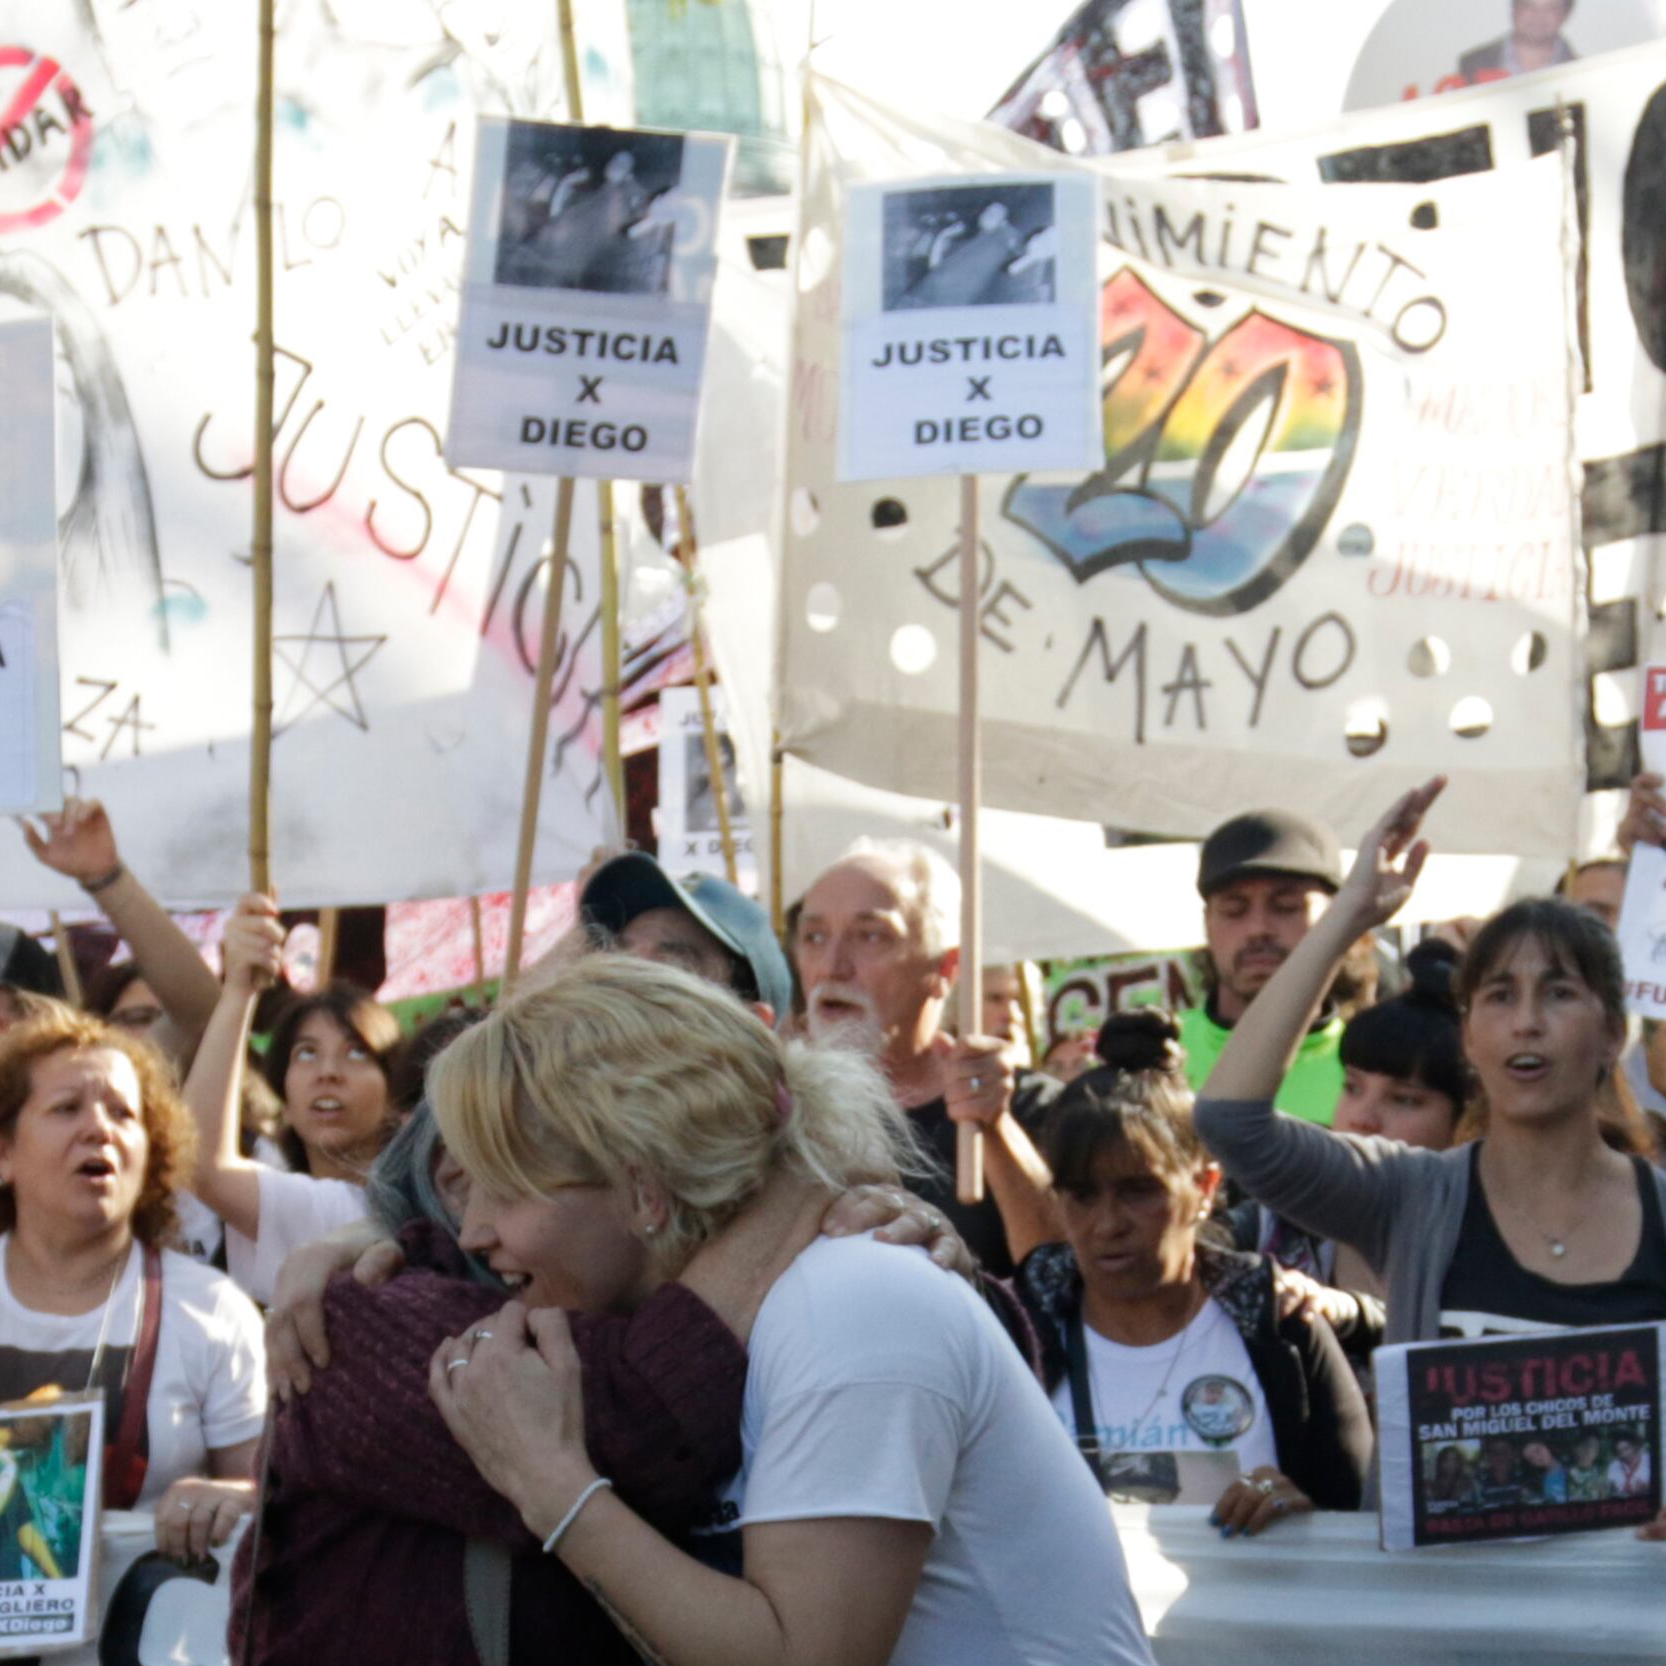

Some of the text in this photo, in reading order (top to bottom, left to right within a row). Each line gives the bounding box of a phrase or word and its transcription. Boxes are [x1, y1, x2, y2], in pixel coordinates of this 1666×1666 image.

[77, 155, 346, 306] DANLO
[486, 321, 679, 365] JUSTICIA
[871, 333, 1067, 368] JUSTICIA
[576, 373, 604, 405] X
[965, 375, 993, 402] X
[519, 414, 649, 452] DIEGO
[914, 413, 1045, 446] DIEGO
[1057, 610, 1357, 745] MAYO
[1426, 1349, 1648, 1406] JUSTICIA
[1418, 1403, 1652, 1442] SAN MIGUEL DEL MONTE
[1450, 1393, 1615, 1422] POR LOS CHICOS DE
[34, 1583, 46, 1597] X
